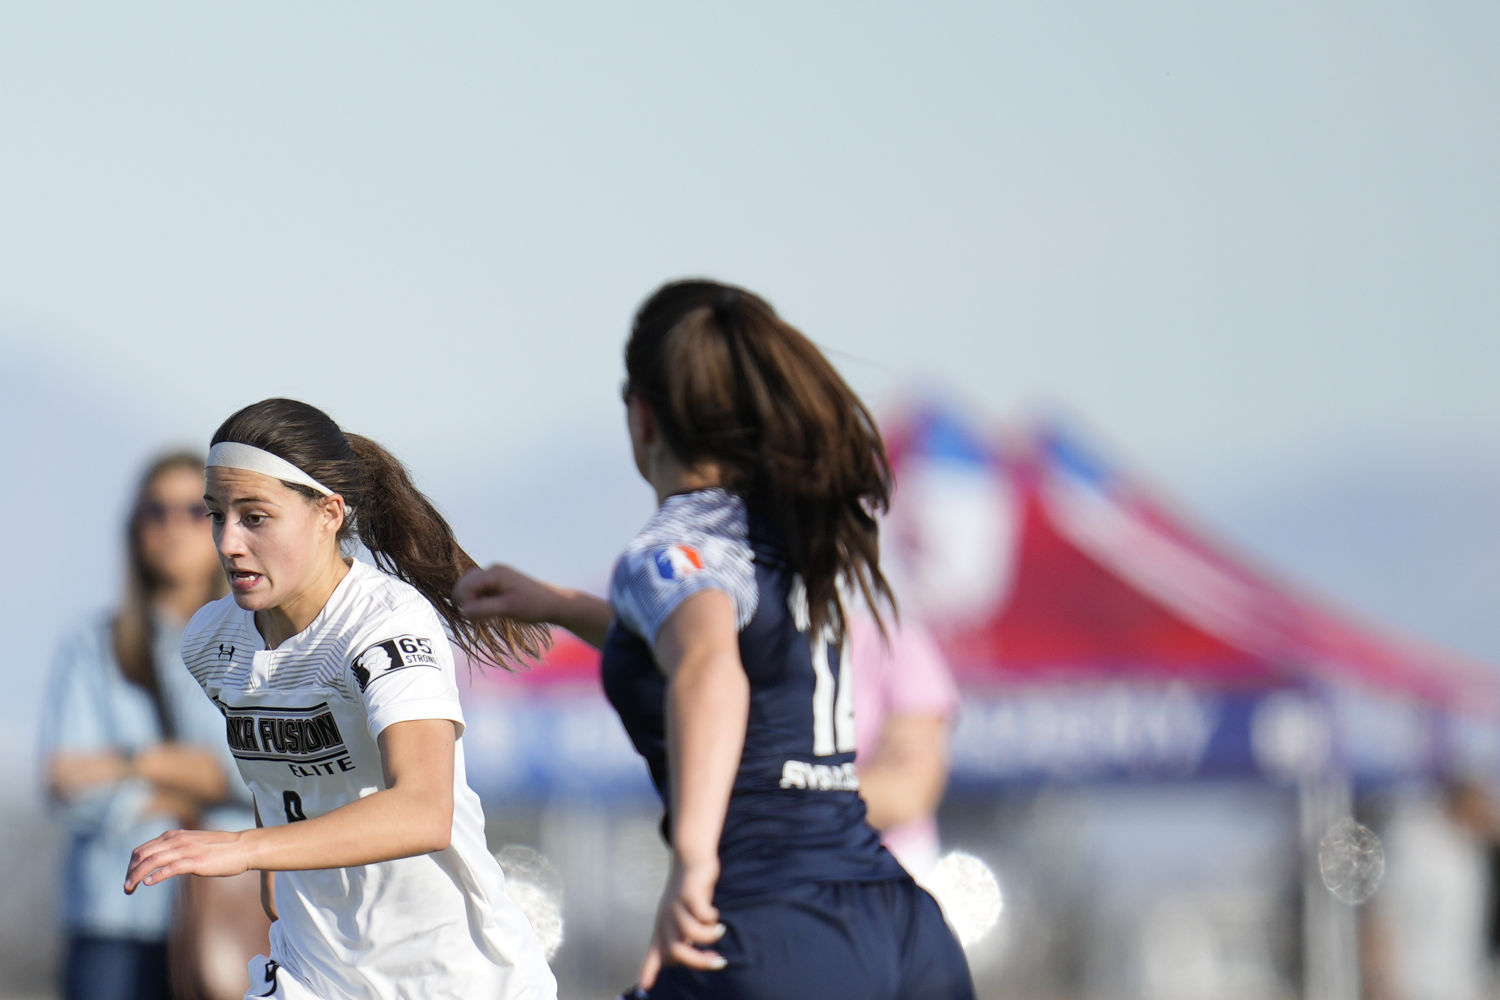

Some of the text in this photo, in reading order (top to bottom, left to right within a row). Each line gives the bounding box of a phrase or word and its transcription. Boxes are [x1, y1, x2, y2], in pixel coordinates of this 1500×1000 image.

[399, 638, 432, 654] 65
[258, 711, 344, 755] FUSION
[288, 756, 356, 777] ELITE
